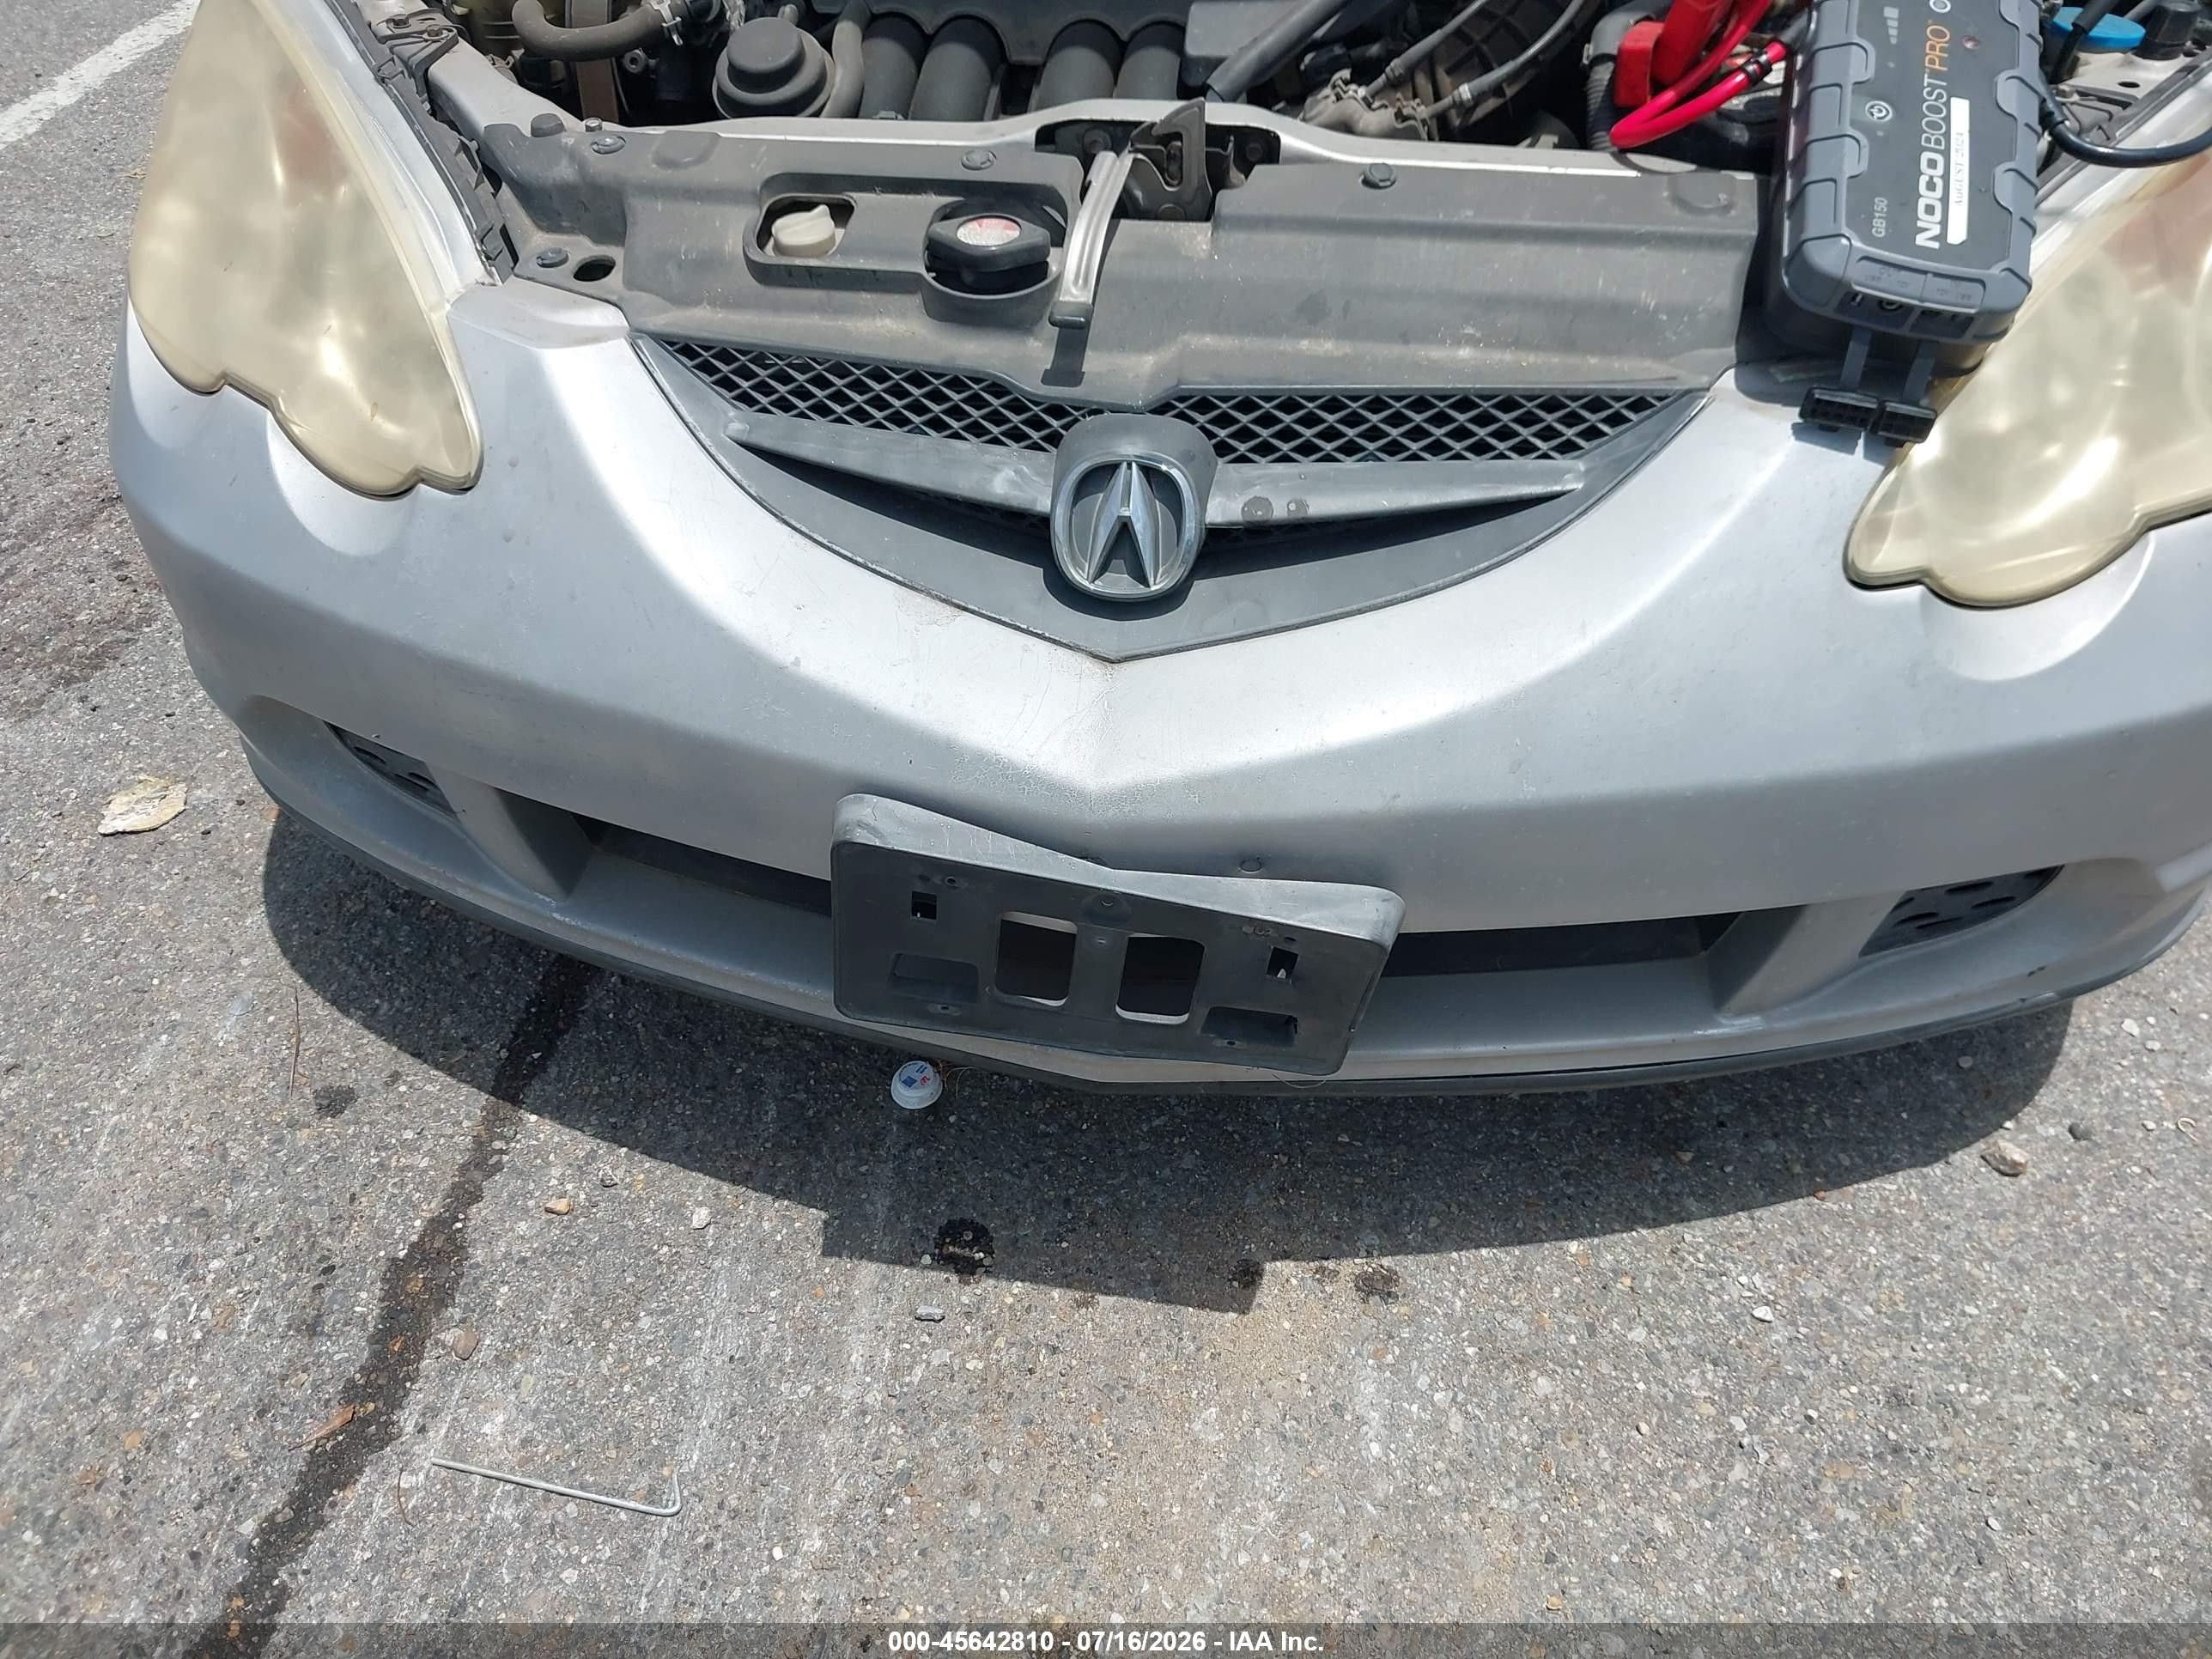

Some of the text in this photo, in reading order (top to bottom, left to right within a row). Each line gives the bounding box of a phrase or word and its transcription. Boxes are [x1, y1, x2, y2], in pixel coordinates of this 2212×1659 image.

[1916, 24, 1951, 249] NOCO BOOST PRO
[1872, 197, 1889, 239] GB150
